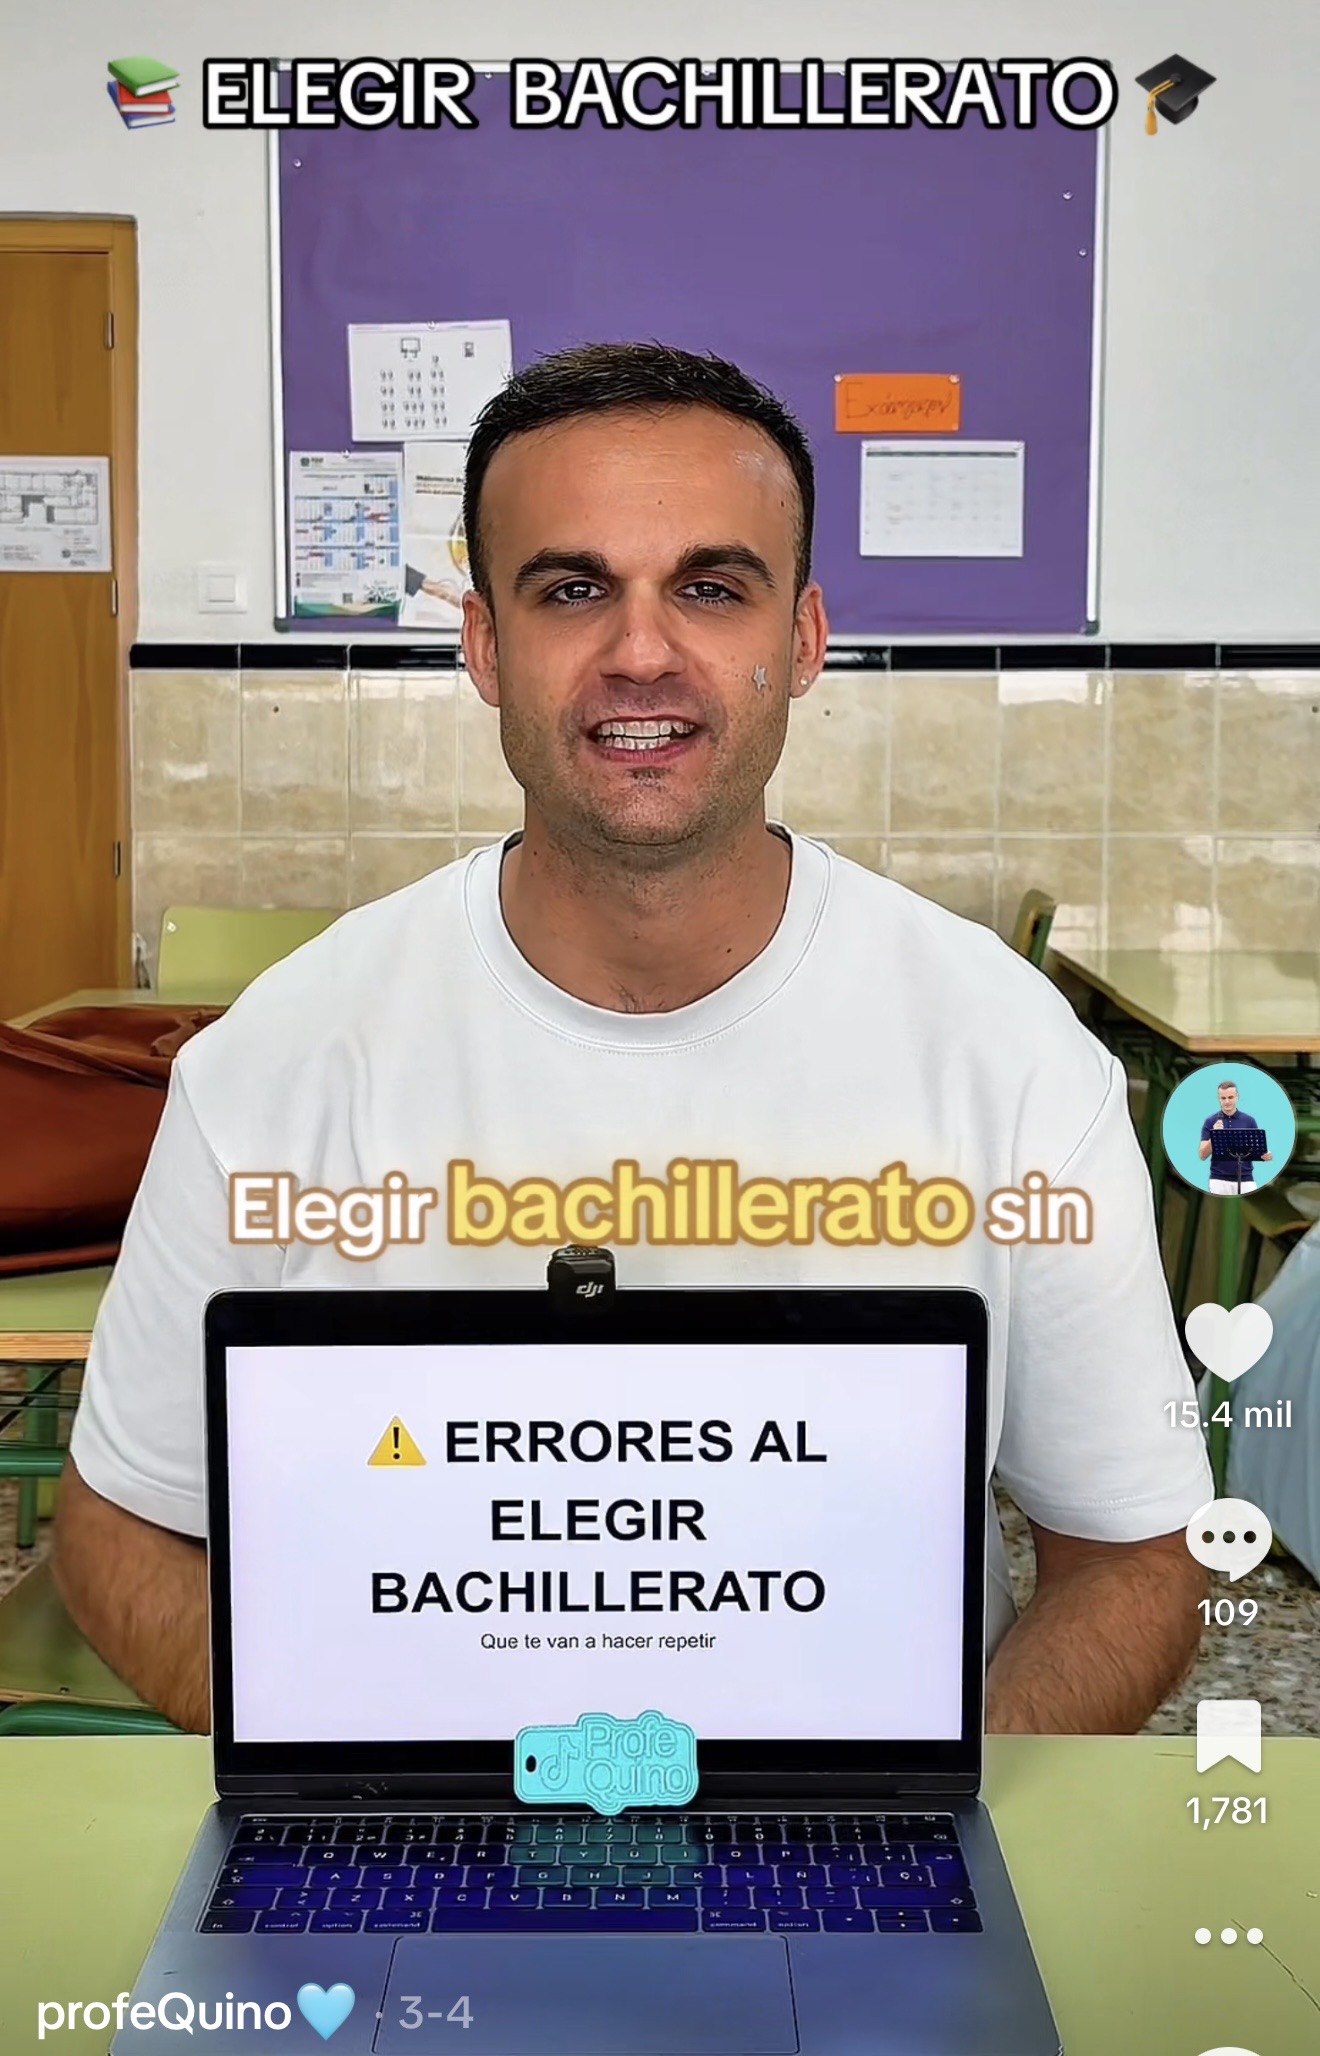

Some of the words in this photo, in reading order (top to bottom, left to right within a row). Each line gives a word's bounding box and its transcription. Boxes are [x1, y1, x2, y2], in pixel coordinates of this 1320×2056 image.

[446, 1420, 734, 1463] ERRORES
[750, 1420, 828, 1463] AL
[491, 1499, 707, 1541] ELEGIR
[372, 1569, 827, 1613] BACHILLERATO
[481, 1633, 518, 1650] Que
[524, 1634, 541, 1650] te
[547, 1638, 579, 1650] van
[585, 1638, 597, 1650] a
[602, 1633, 653, 1650] hacer
[658, 1633, 717, 1653] repetir
[585, 1716, 678, 1760] Profe
[584, 1757, 688, 1801] Quino
